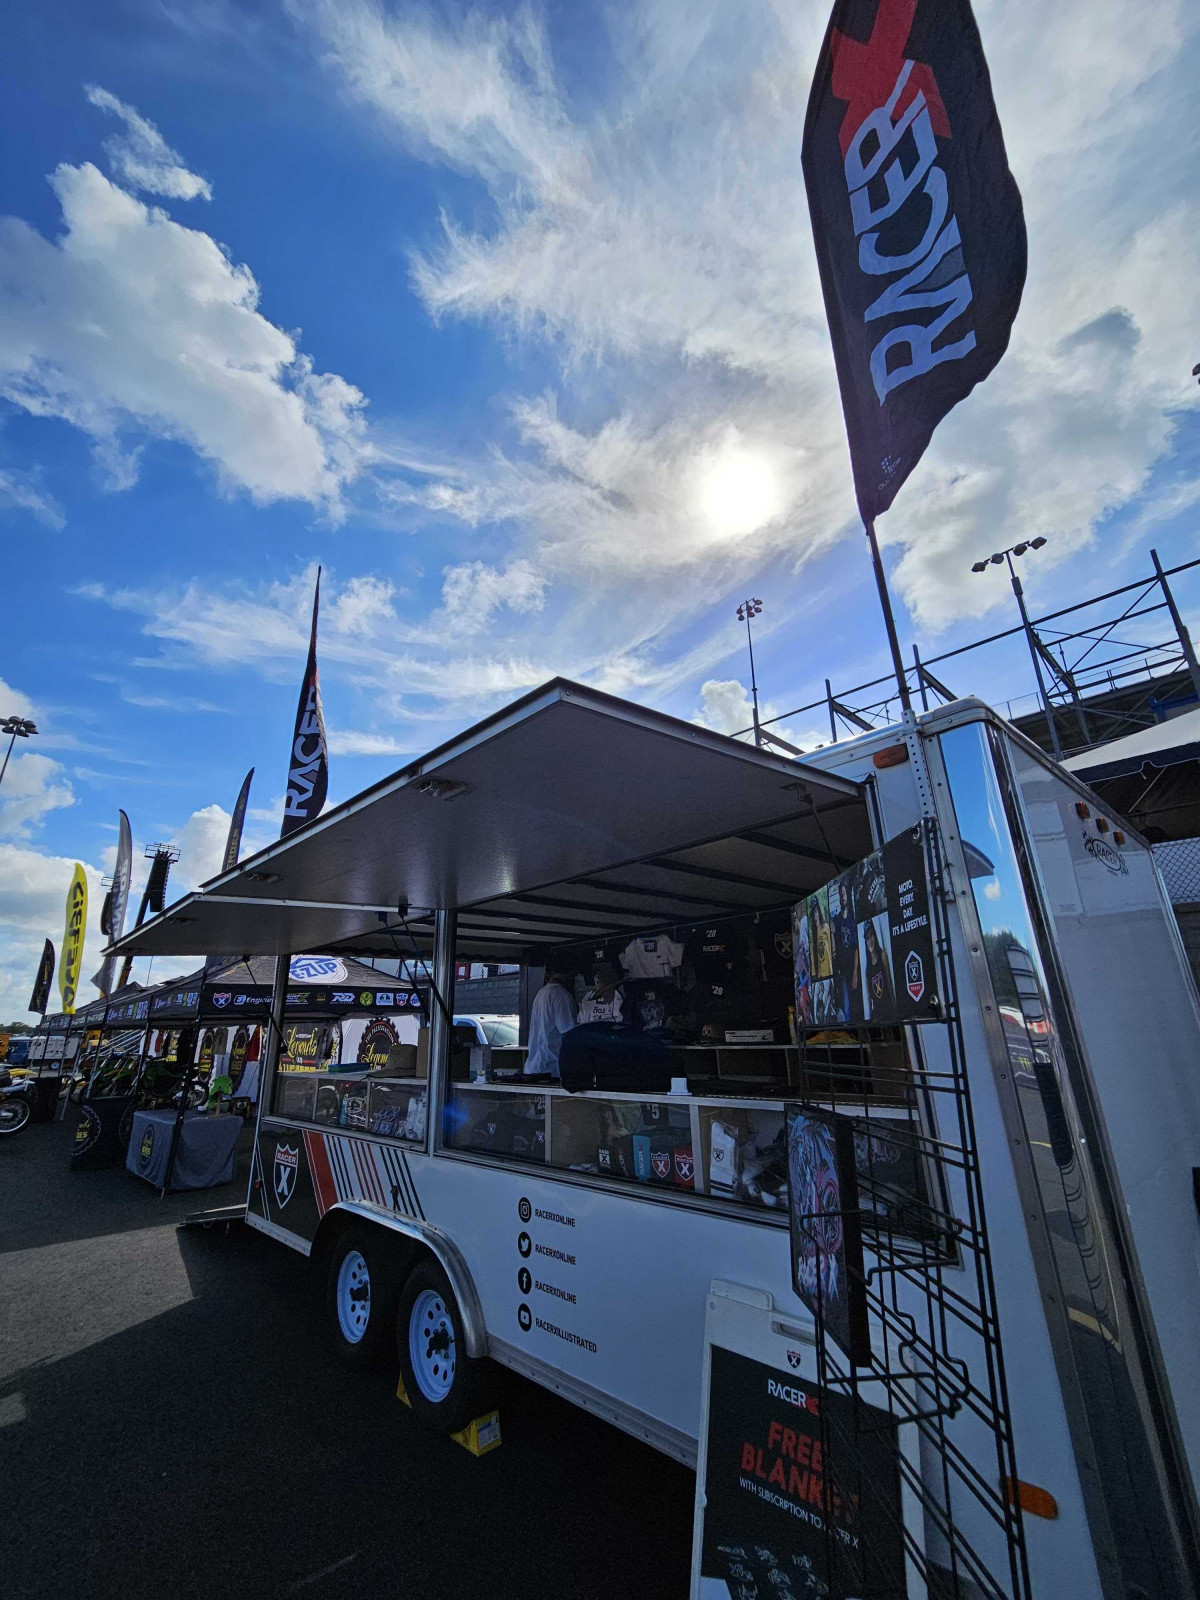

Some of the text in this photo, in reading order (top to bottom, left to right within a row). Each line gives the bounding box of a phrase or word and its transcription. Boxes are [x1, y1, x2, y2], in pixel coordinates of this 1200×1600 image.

[277, 1152, 297, 1164] RACER
[657, 1160, 666, 1173] X
[277, 1164, 291, 1196] X
[681, 1163, 690, 1176] X
[534, 1208, 576, 1228] RACERXONLINE
[535, 1244, 577, 1265] RACERXONLINE
[535, 1281, 577, 1305] RACERXONLINE
[535, 1317, 597, 1353] RACERXILLUSTRATED
[739, 1476, 823, 1529] WITH SUBSCRIPTION TO
